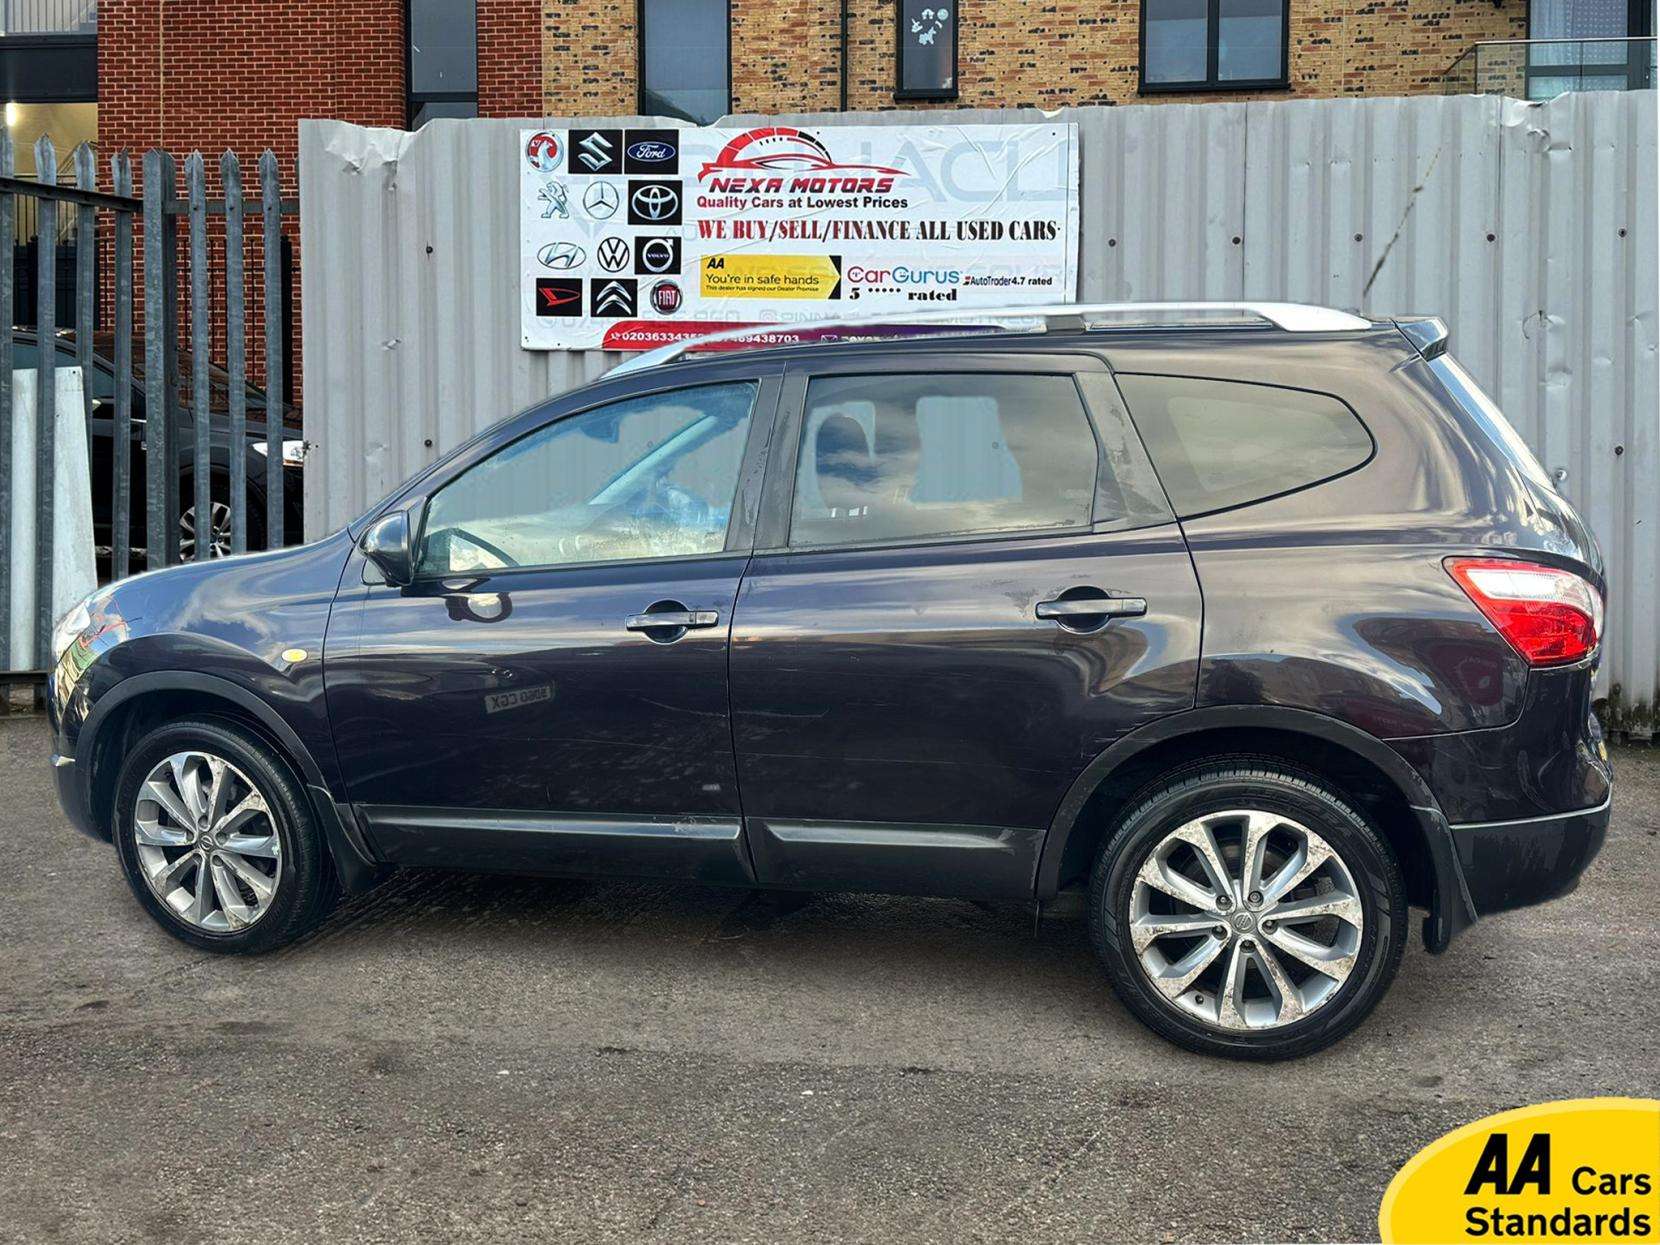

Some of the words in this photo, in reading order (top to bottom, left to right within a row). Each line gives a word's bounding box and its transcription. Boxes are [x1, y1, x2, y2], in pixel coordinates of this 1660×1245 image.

[636, 144, 667, 160] Ford
[708, 177, 784, 194] NEXA
[789, 177, 895, 194] MOTORS
[696, 196, 747, 211] Quality
[751, 196, 784, 209] Cars
[788, 196, 802, 209] at
[807, 196, 859, 209] Lowest
[863, 195, 909, 209] Prices
[697, 219, 727, 240] WE
[733, 219, 911, 243] BUY/SELL/FINANCE
[916, 220, 951, 241] ALL
[956, 220, 1004, 241] USED
[707, 257, 725, 269] AA
[705, 273, 741, 284] You're
[744, 275, 754, 284] in
[757, 274, 781, 285] safe
[784, 274, 820, 285] hands
[847, 265, 961, 285] CarGurus
[1028, 277, 1053, 286] rated
[658, 290, 676, 306] FIAT
[849, 287, 860, 300] 5
[908, 288, 957, 301] rated
